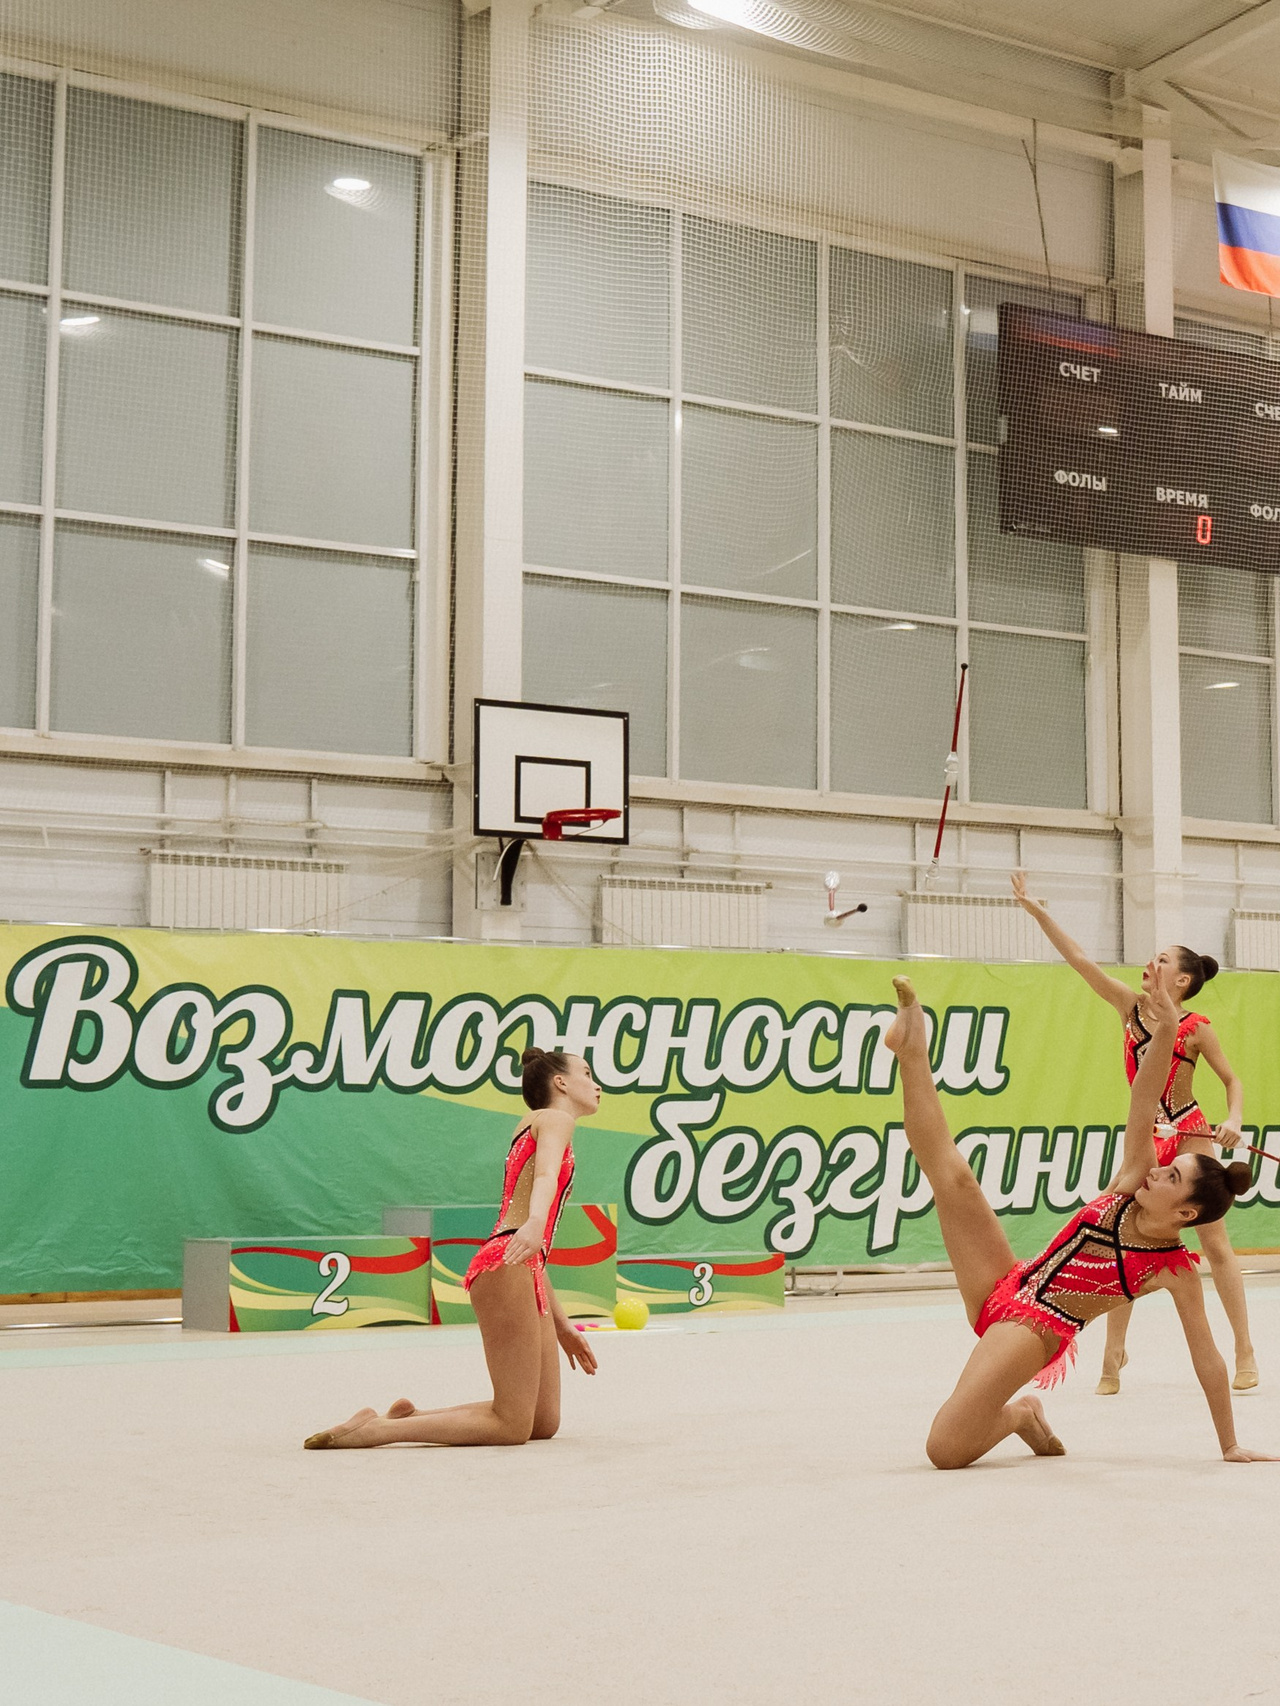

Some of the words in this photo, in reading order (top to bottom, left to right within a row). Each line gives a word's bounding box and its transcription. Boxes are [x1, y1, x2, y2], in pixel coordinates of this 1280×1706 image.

[1059, 361, 1101, 383] СЧЕТ
[1158, 382, 1203, 404] ТАЙМ
[1054, 469, 1107, 492] ФОЛЫ
[1155, 487, 1209, 509] ВРЕМЯ
[1196, 515, 1212, 545] 0
[311, 1251, 352, 1317] 2
[688, 1262, 715, 1307] 3
